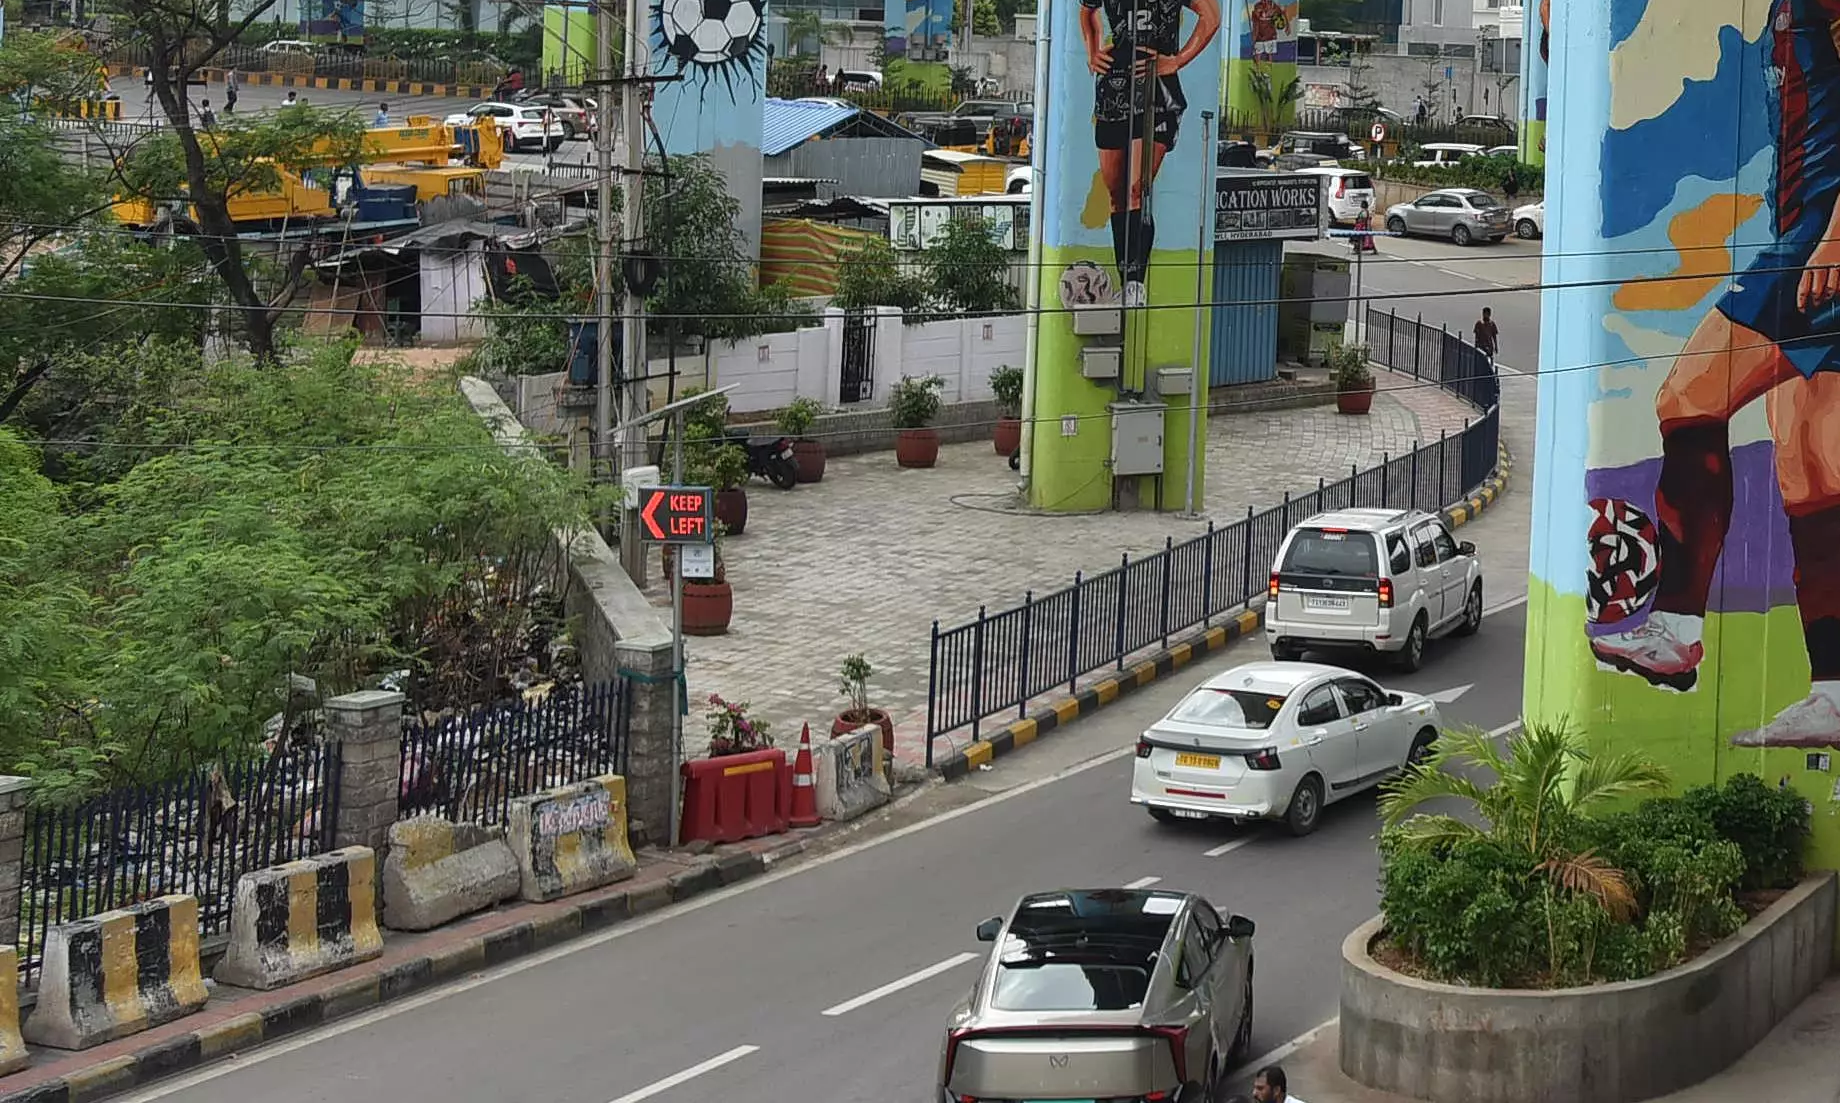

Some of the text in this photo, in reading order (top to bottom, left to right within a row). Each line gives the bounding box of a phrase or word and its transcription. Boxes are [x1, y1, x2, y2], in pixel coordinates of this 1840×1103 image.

[1127, 9, 1153, 31] 12
[1271, 186, 1316, 207] WORKS
[669, 495, 703, 512] KEEP
[669, 516, 704, 535] LEFT
